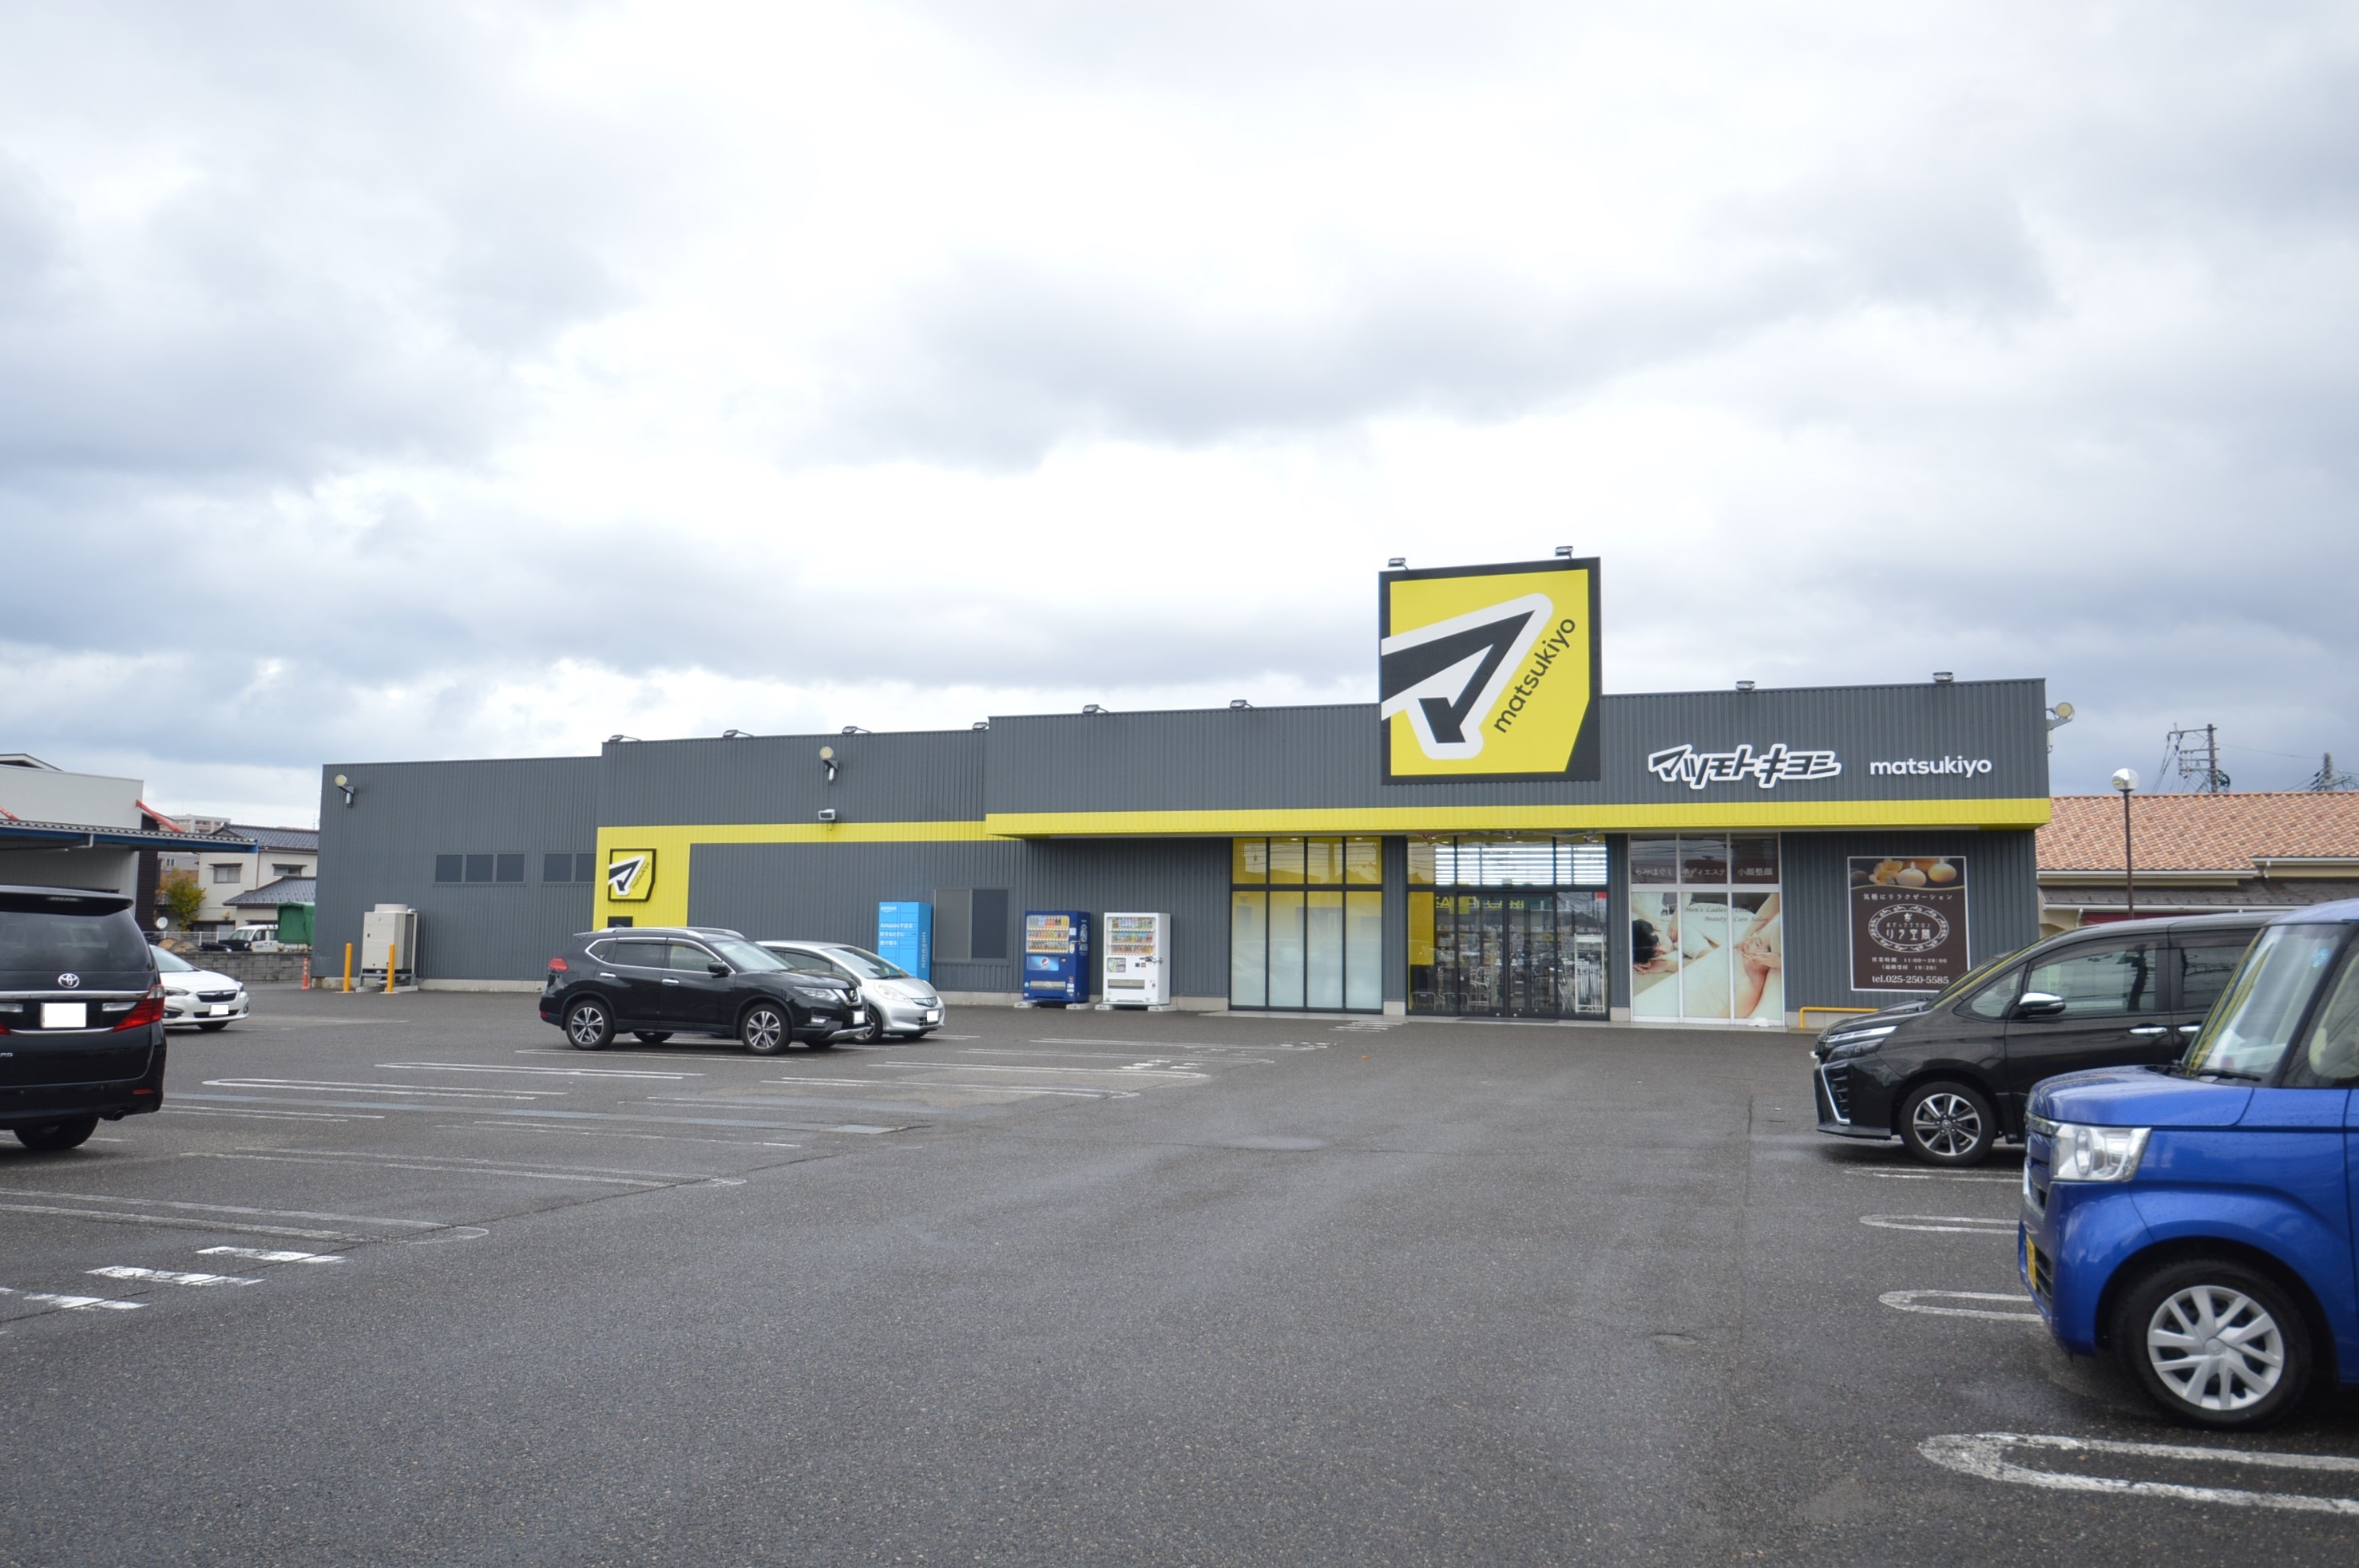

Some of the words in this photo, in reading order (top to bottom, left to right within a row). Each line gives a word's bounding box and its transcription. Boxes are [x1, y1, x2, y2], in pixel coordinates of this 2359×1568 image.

[1493, 618, 1576, 734] matsukiyo
[1648, 743, 1842, 790] マツモトキヨシ
[1869, 756, 1992, 778] matsukiyo
